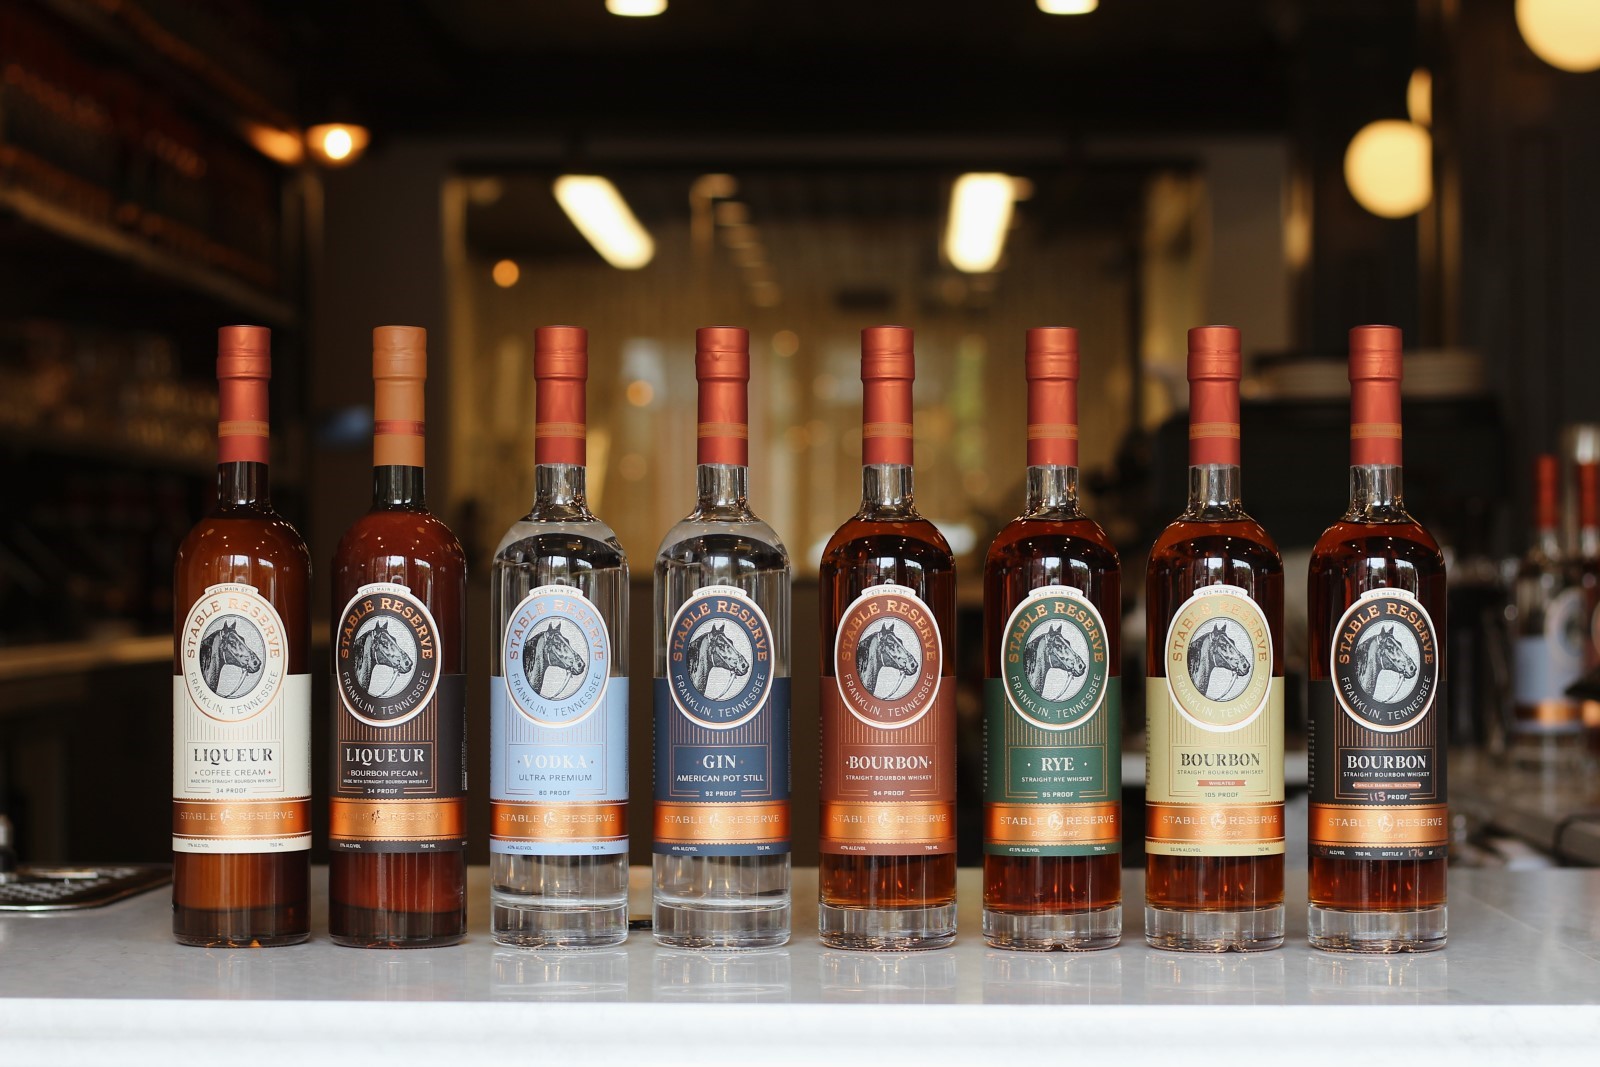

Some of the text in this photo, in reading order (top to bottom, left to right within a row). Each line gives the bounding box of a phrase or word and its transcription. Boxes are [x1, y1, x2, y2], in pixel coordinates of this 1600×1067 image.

[188, 598, 280, 658] STABLE RESERVE
[342, 598, 433, 659] STABLE RESERVE
[510, 600, 603, 660] STABLE RESERVE
[674, 601, 767, 662] STABLE RESERVE
[842, 600, 935, 660] STABLE RESERVE
[1009, 602, 1103, 663] STABLE RESERVE
[1173, 601, 1266, 662] STABLE RESERVE
[1339, 602, 1433, 664] STABLE RESERVE
[190, 671, 278, 715] FRANKLIN, TENNESSEE
[343, 671, 430, 715] FRANKLIN, TENNESSEE
[512, 673, 601, 717] FRANKLIN, TENNESSEE
[676, 674, 765, 718] FRANKLIN, TENNESSEE
[845, 673, 933, 717] FRANKLIN, TENNESSEE
[1012, 674, 1100, 719] FRANKLIN, TENNESSEE
[1342, 676, 1431, 720] FRANKLIN, TENNESSEE
[194, 748, 273, 765] LIQUEUR
[346, 748, 424, 766] LIQUEUR
[523, 755, 587, 768] VODKA
[702, 755, 736, 768] GIN
[849, 756, 928, 769] BOURBON
[1041, 758, 1074, 771] RYE
[1181, 753, 1260, 766] BOURBON
[1347, 756, 1426, 768] BOURBON
[1369, 792, 1386, 801] 113
[180, 811, 294, 820] STABLE RESERVE
[500, 814, 615, 822] STABLE RESERVE
[664, 815, 779, 823] STABLE RESERVE
[832, 814, 946, 823] STABLE RESERVE
[1000, 815, 1114, 825] STABLE RESERVE
[1163, 815, 1277, 825] STABLE RESERVE
[1329, 818, 1442, 826] STABLE RESERVE
